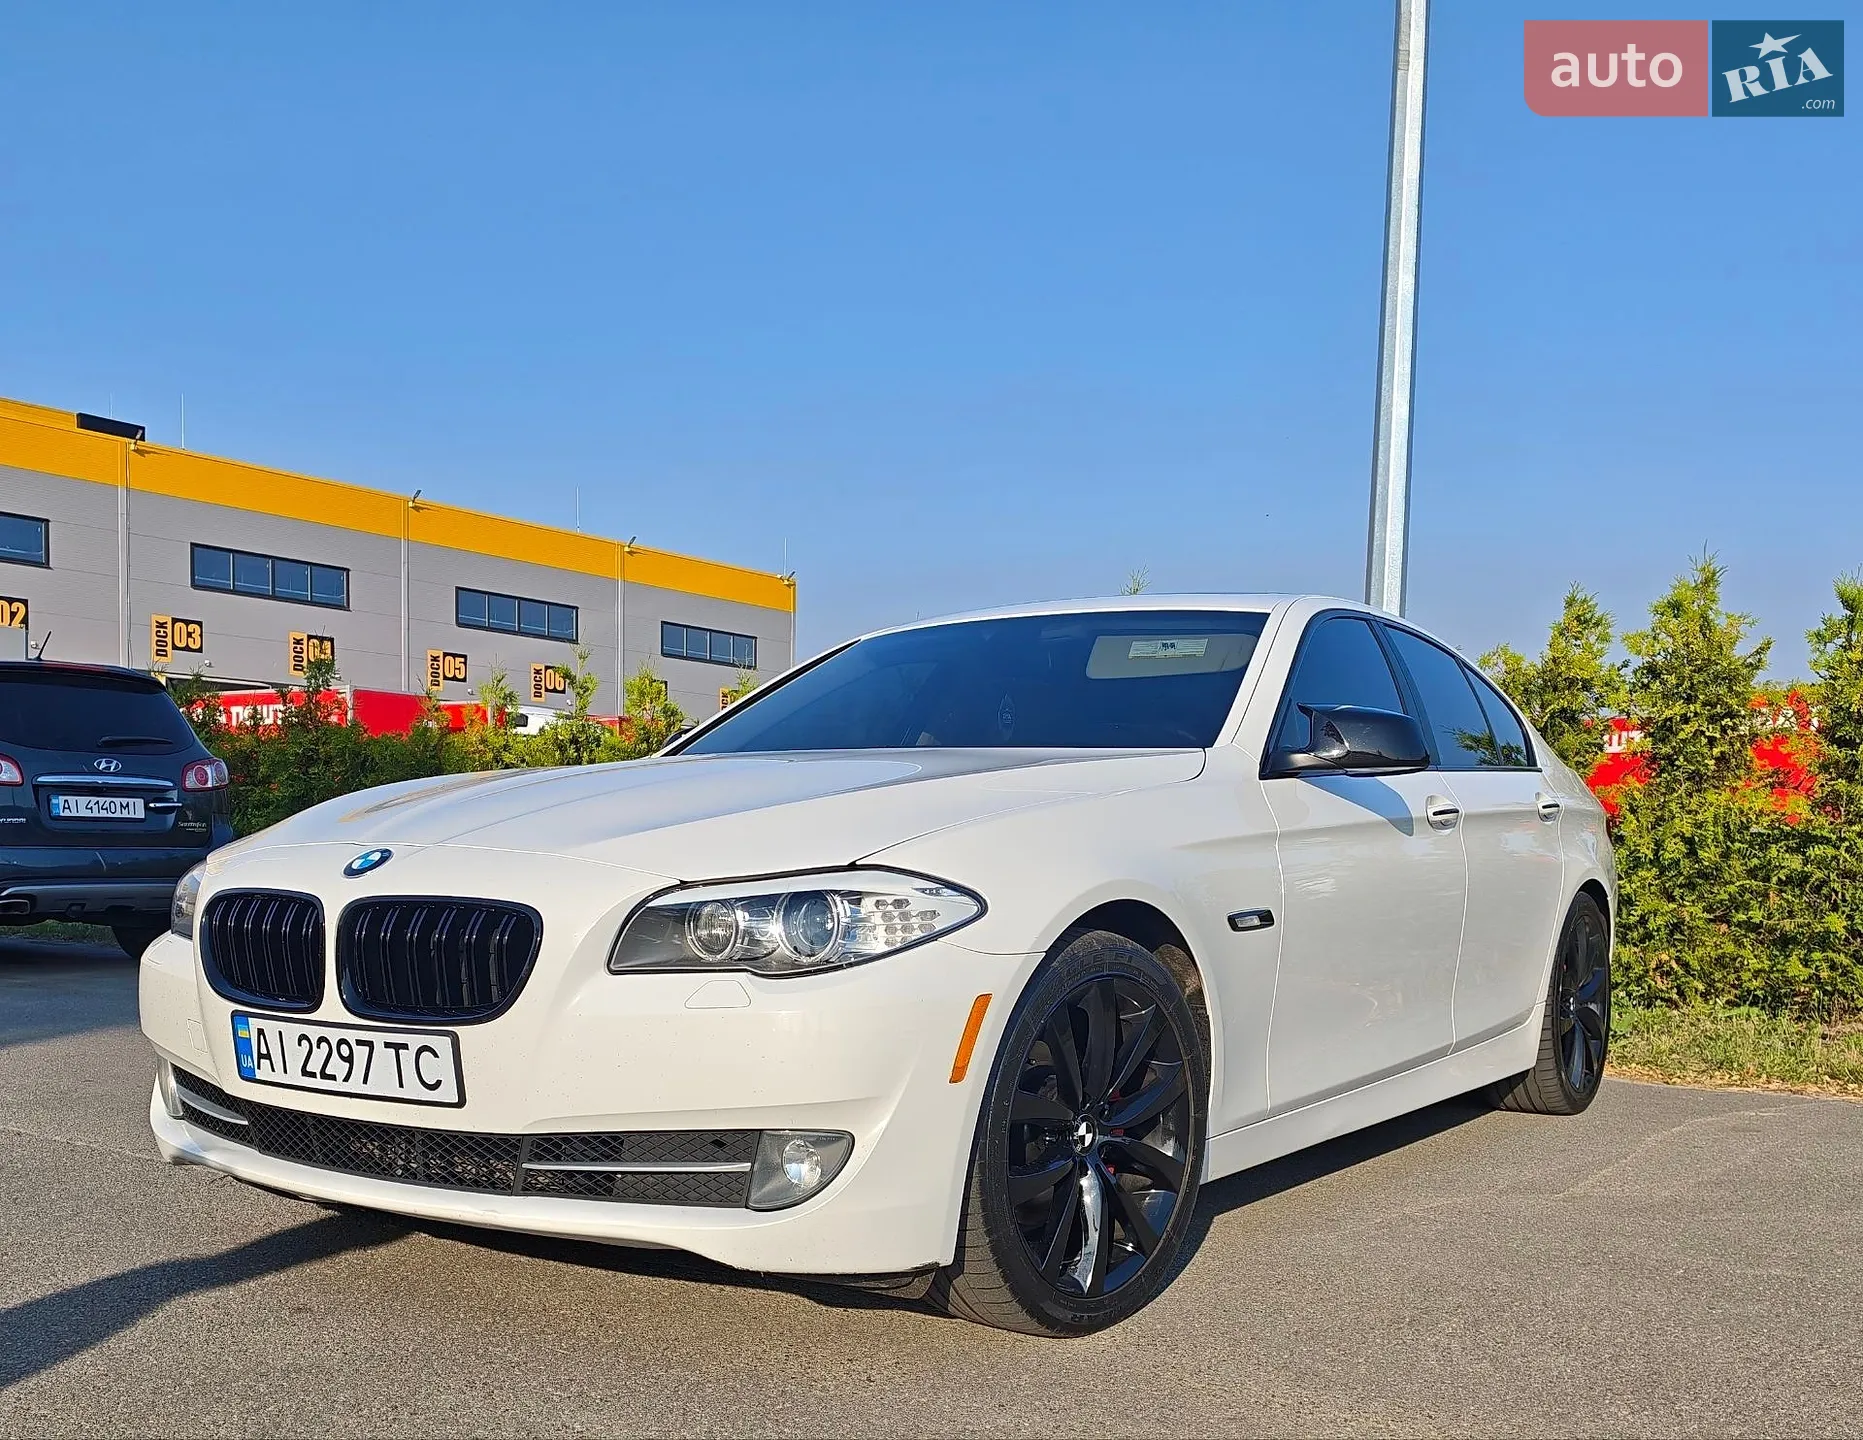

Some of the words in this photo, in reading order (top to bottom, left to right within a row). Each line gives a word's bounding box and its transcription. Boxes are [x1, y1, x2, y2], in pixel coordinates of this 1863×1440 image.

[0, 599, 26, 628] 02
[154, 619, 169, 658] DOCK
[173, 622, 202, 650] 03
[292, 636, 305, 672] DOCK
[430, 654, 441, 687] DOCK
[444, 655, 466, 679] 05
[533, 667, 543, 698] DOCK
[545, 668, 565, 691] 06
[61, 799, 79, 814] AI
[84, 799, 117, 815] 4140
[120, 801, 137, 816] MI
[240, 1053, 254, 1069] UA
[256, 1027, 288, 1075] AI
[297, 1033, 375, 1085] 2297
[383, 1040, 443, 1092] TC
